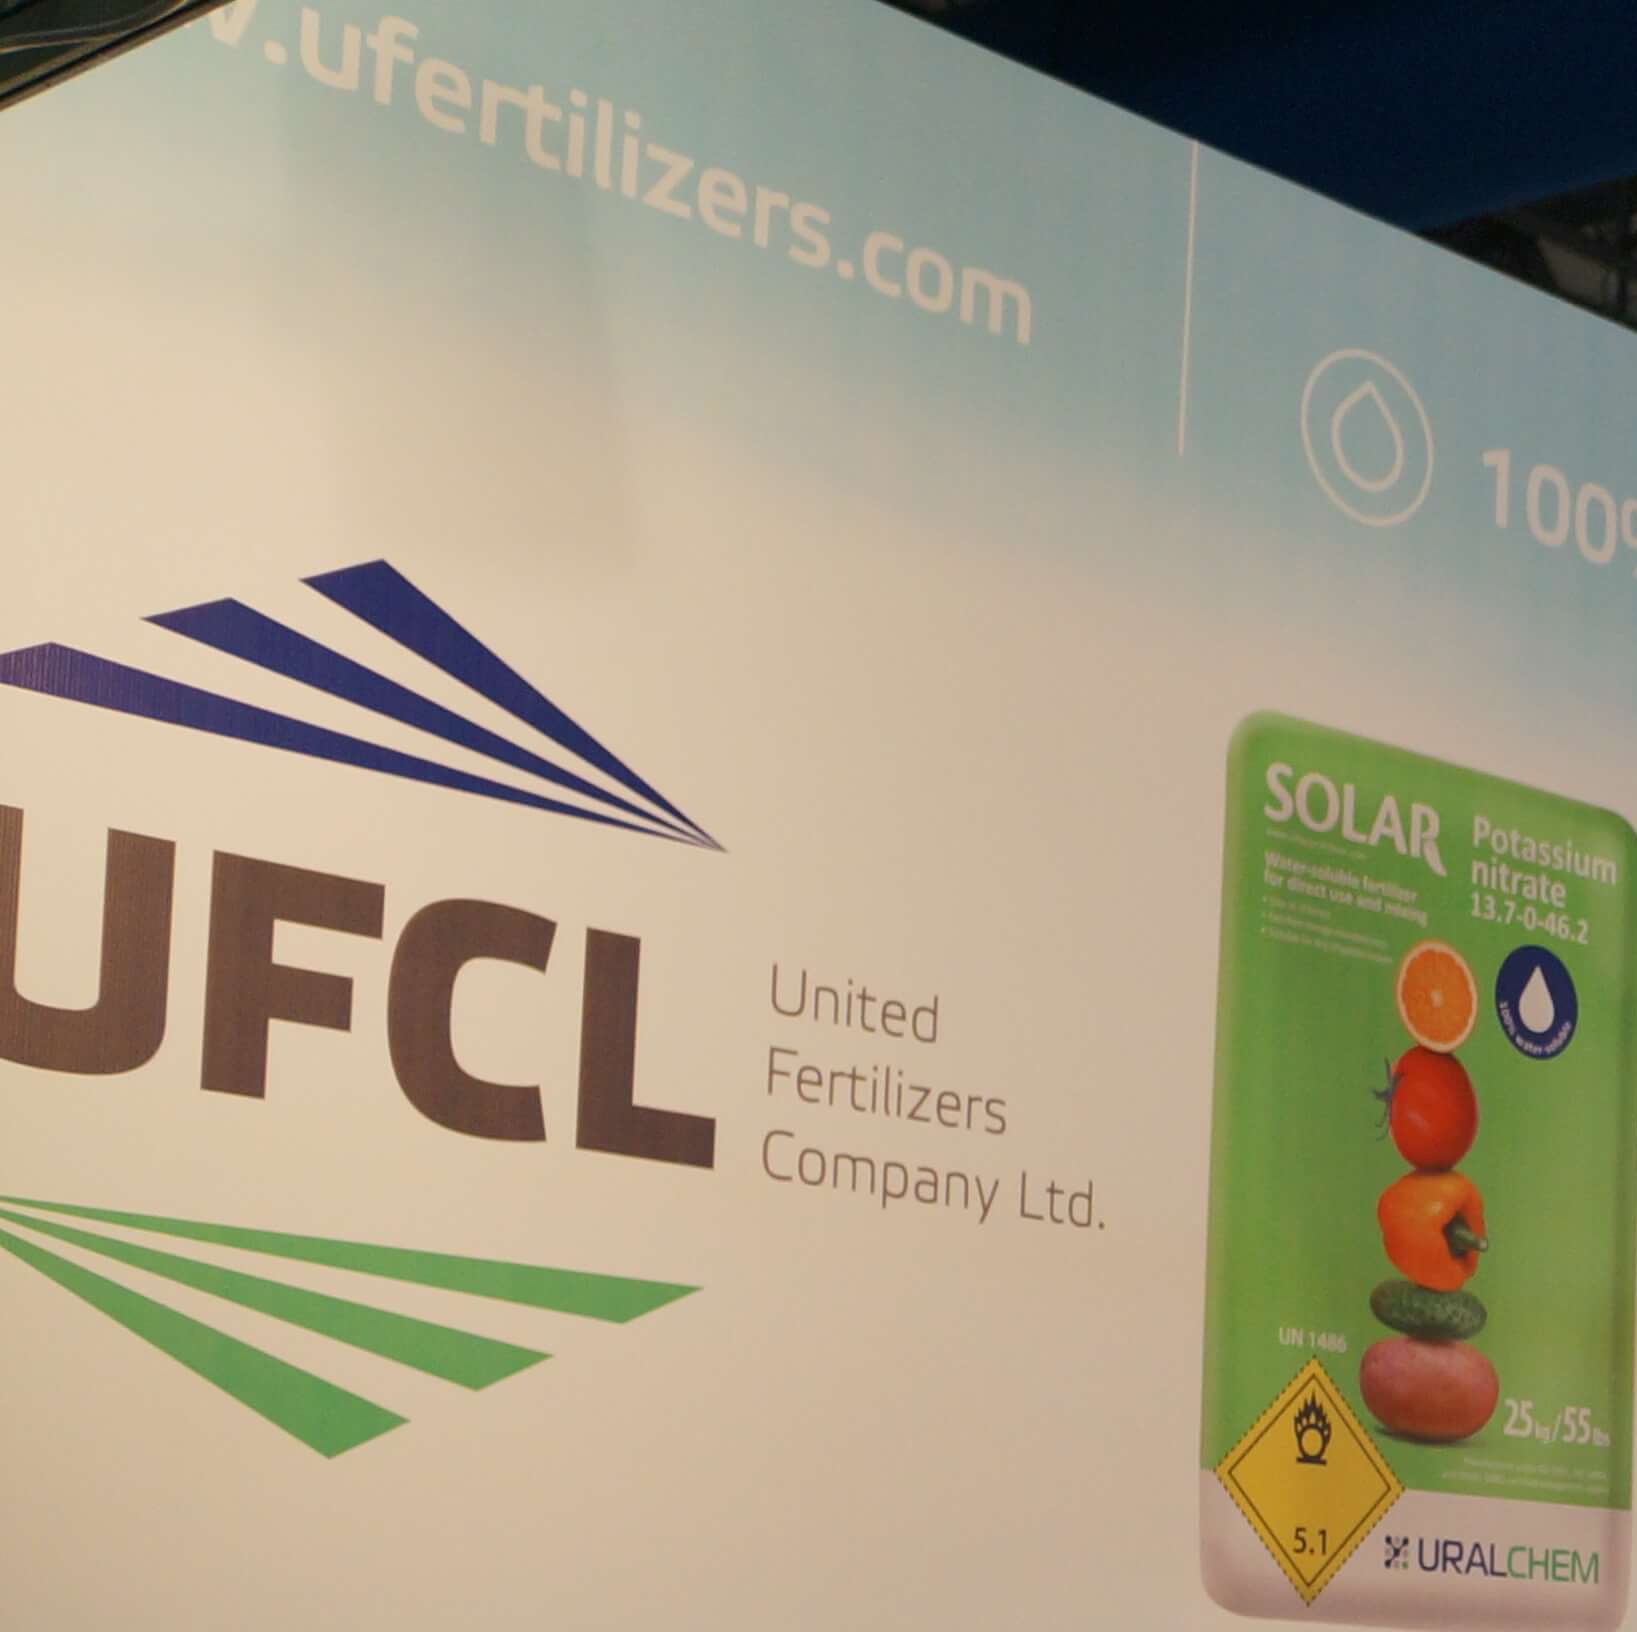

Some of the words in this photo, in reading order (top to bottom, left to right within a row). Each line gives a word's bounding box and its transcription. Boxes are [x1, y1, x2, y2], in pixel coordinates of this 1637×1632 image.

[1264, 761, 1447, 877] SOLAR
[1472, 815, 1618, 886] Potassium
[1471, 859, 1567, 908] nitrate
[1471, 893, 1590, 945] 13.7-0-46.2
[0, 806, 716, 1170] UFCL
[768, 962, 939, 1046] United
[765, 1045, 1009, 1137] Fertilizers
[760, 1129, 999, 1224] Company
[1018, 1170, 1107, 1231] Ltd.
[1278, 1327, 1304, 1347] UN
[1292, 1527, 1328, 1556] 5.1
[1418, 1537, 1600, 1585] URALCHEM
